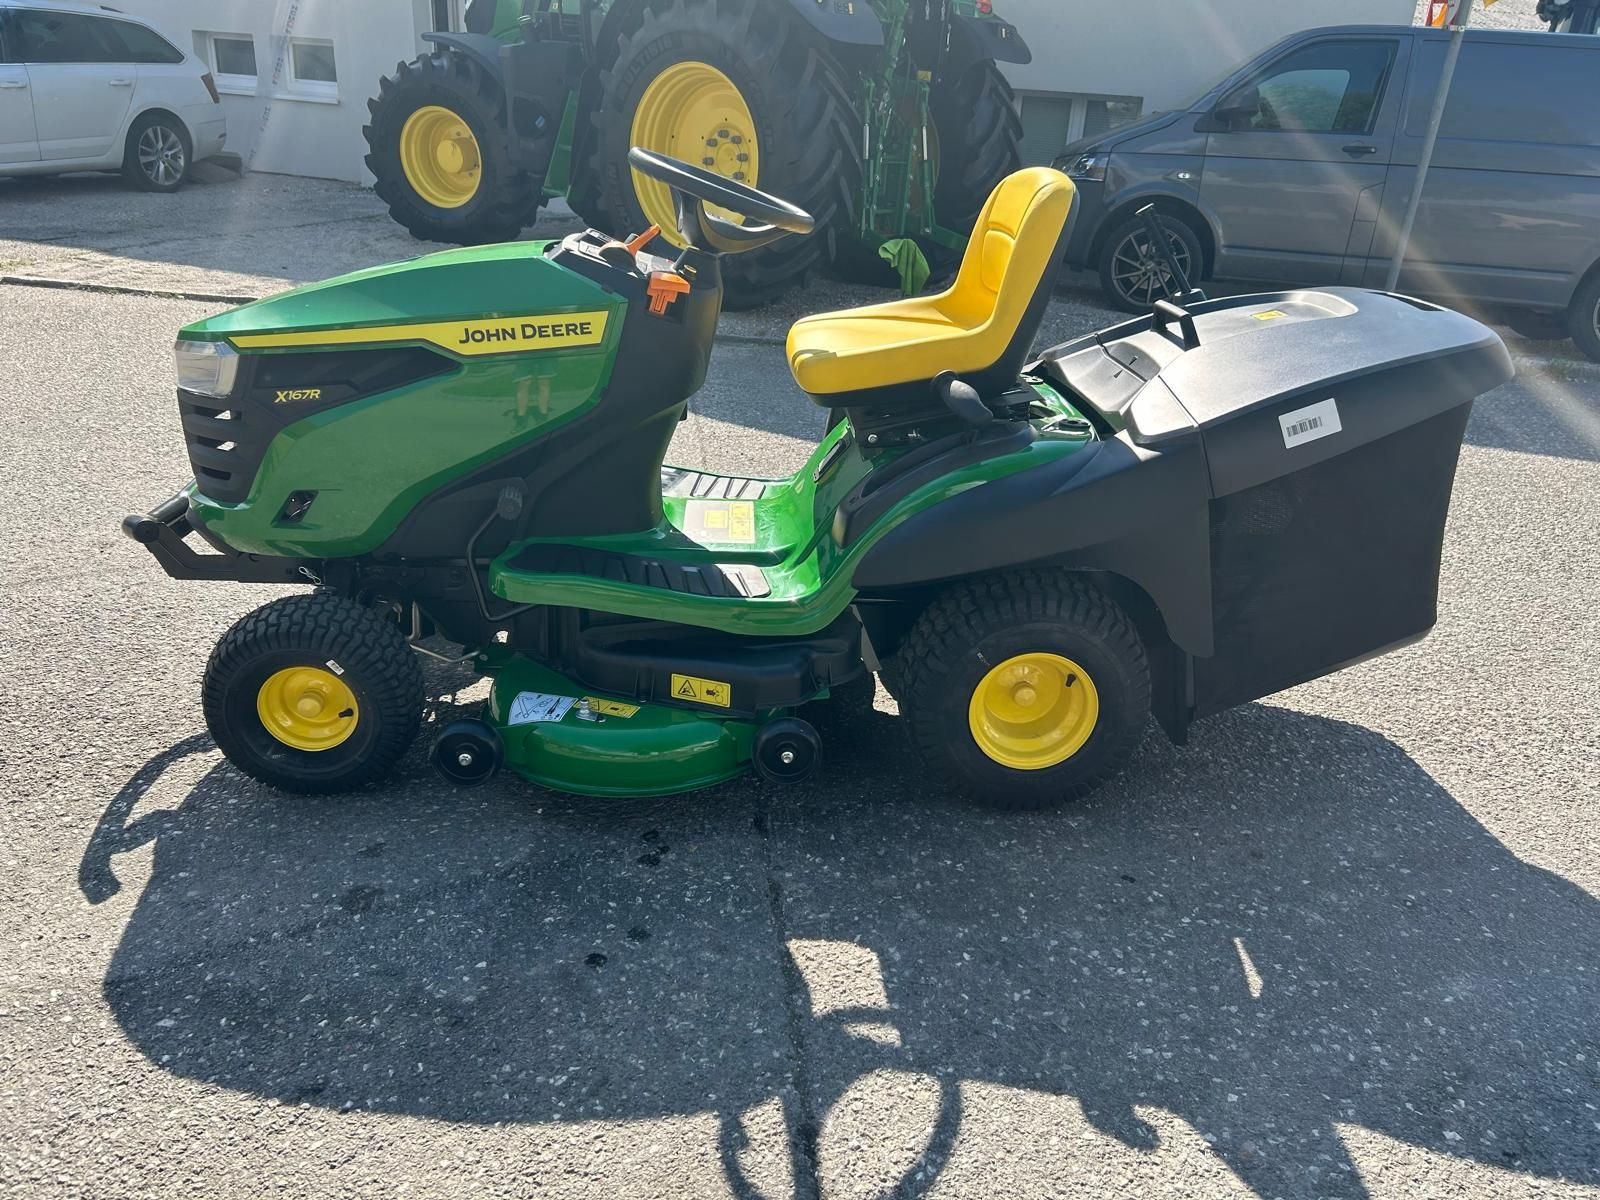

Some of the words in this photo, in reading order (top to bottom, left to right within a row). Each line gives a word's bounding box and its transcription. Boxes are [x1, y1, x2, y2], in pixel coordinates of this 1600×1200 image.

[459, 327, 516, 344] JOHN
[520, 321, 593, 340] DEERE
[273, 389, 321, 403] X167R
